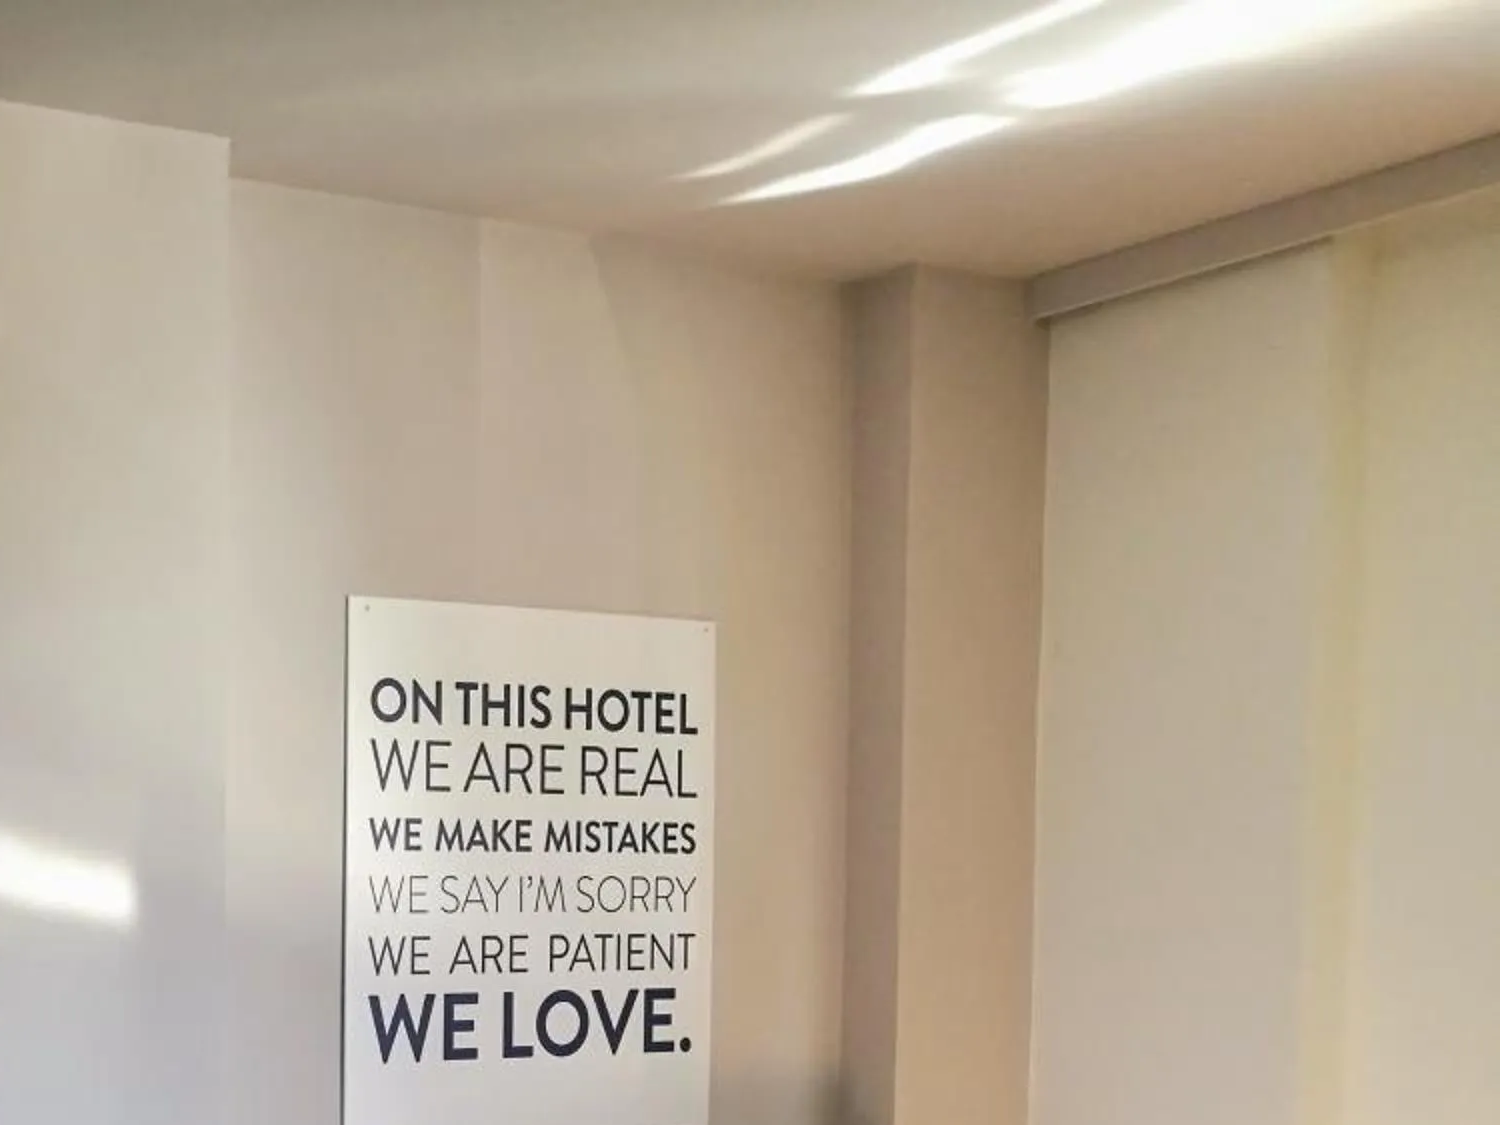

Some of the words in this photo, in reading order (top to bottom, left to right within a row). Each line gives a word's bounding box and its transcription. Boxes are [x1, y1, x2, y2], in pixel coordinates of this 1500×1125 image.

[369, 676, 444, 727] ON
[453, 680, 554, 730] THIS
[563, 686, 699, 737] HOTEL
[368, 736, 453, 794] WE
[462, 740, 566, 796] ARE
[579, 744, 699, 800] REAL
[367, 816, 424, 853] WE
[433, 817, 533, 854] MAKE
[543, 819, 698, 856] MISTAKES
[368, 874, 430, 915] WE
[439, 873, 511, 915] SAY
[518, 873, 568, 914] I'M
[575, 874, 698, 914] SORRY
[367, 934, 433, 977] WE
[448, 932, 530, 976] ARE
[548, 932, 698, 974] PATIENT
[367, 991, 480, 1065] WE
[501, 986, 693, 1060] LOVE.
